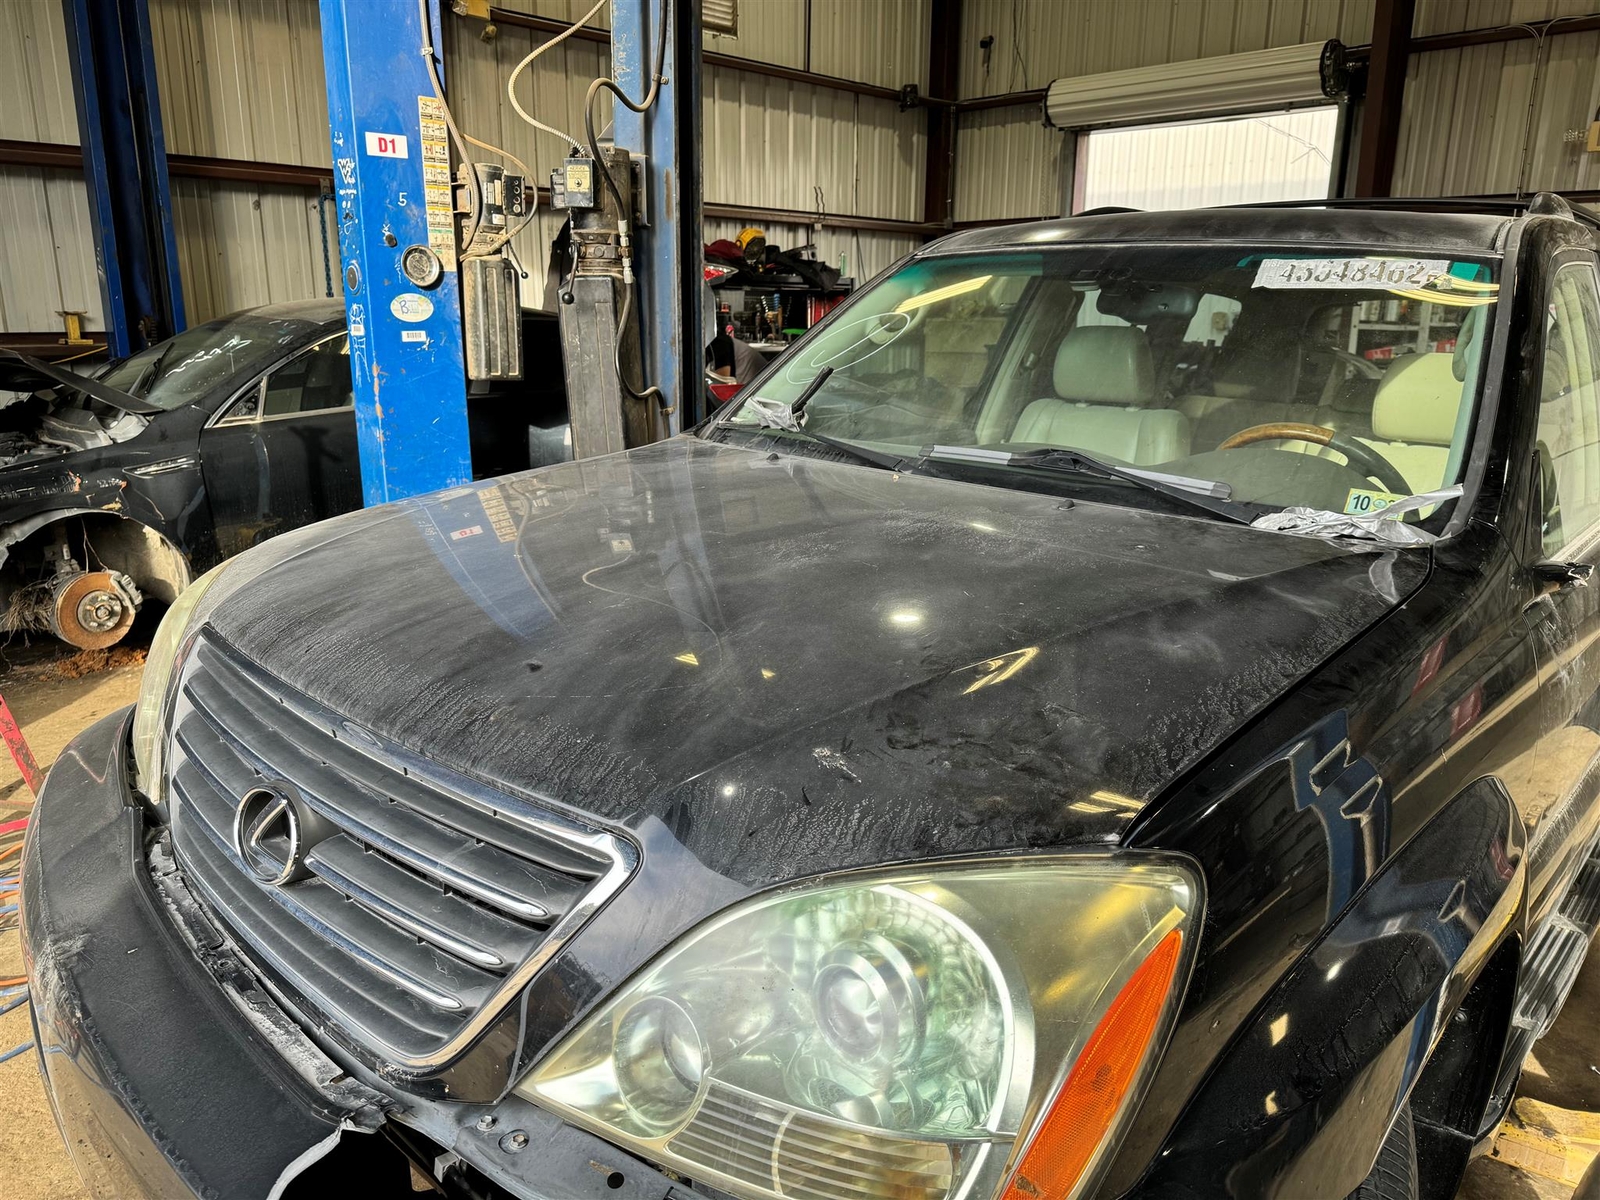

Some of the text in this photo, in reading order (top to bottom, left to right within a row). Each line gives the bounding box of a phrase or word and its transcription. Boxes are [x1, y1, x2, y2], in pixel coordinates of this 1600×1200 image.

[378, 136, 397, 154] D1
[398, 192, 407, 207] 5
[1353, 494, 1371, 511] 10
